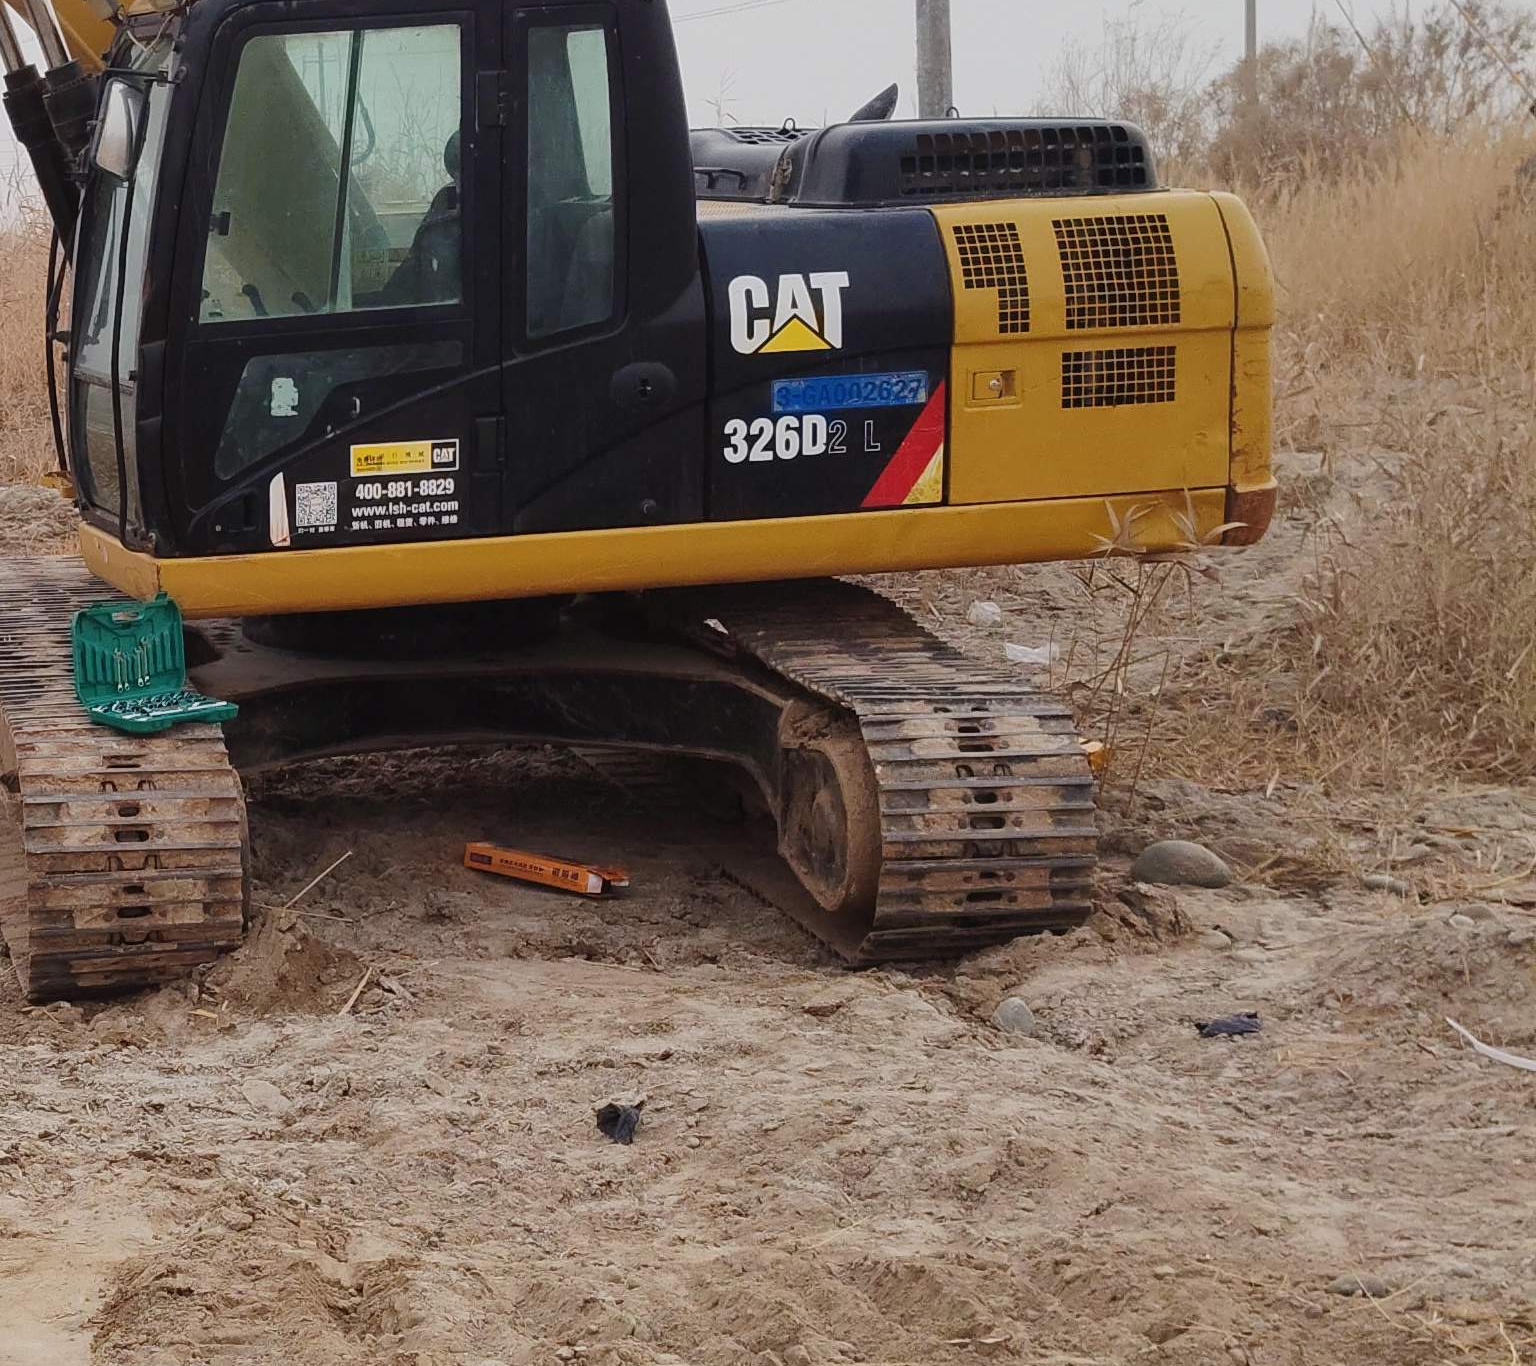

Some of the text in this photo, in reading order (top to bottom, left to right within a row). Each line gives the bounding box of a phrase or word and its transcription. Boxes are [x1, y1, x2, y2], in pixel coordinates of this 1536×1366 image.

[727, 271, 850, 355] CAT
[864, 420, 881, 452] L
[432, 447, 456, 464] CAT
[355, 478, 455, 500] 400-881-8829
[351, 500, 459, 517] www.lsh-cat.com
